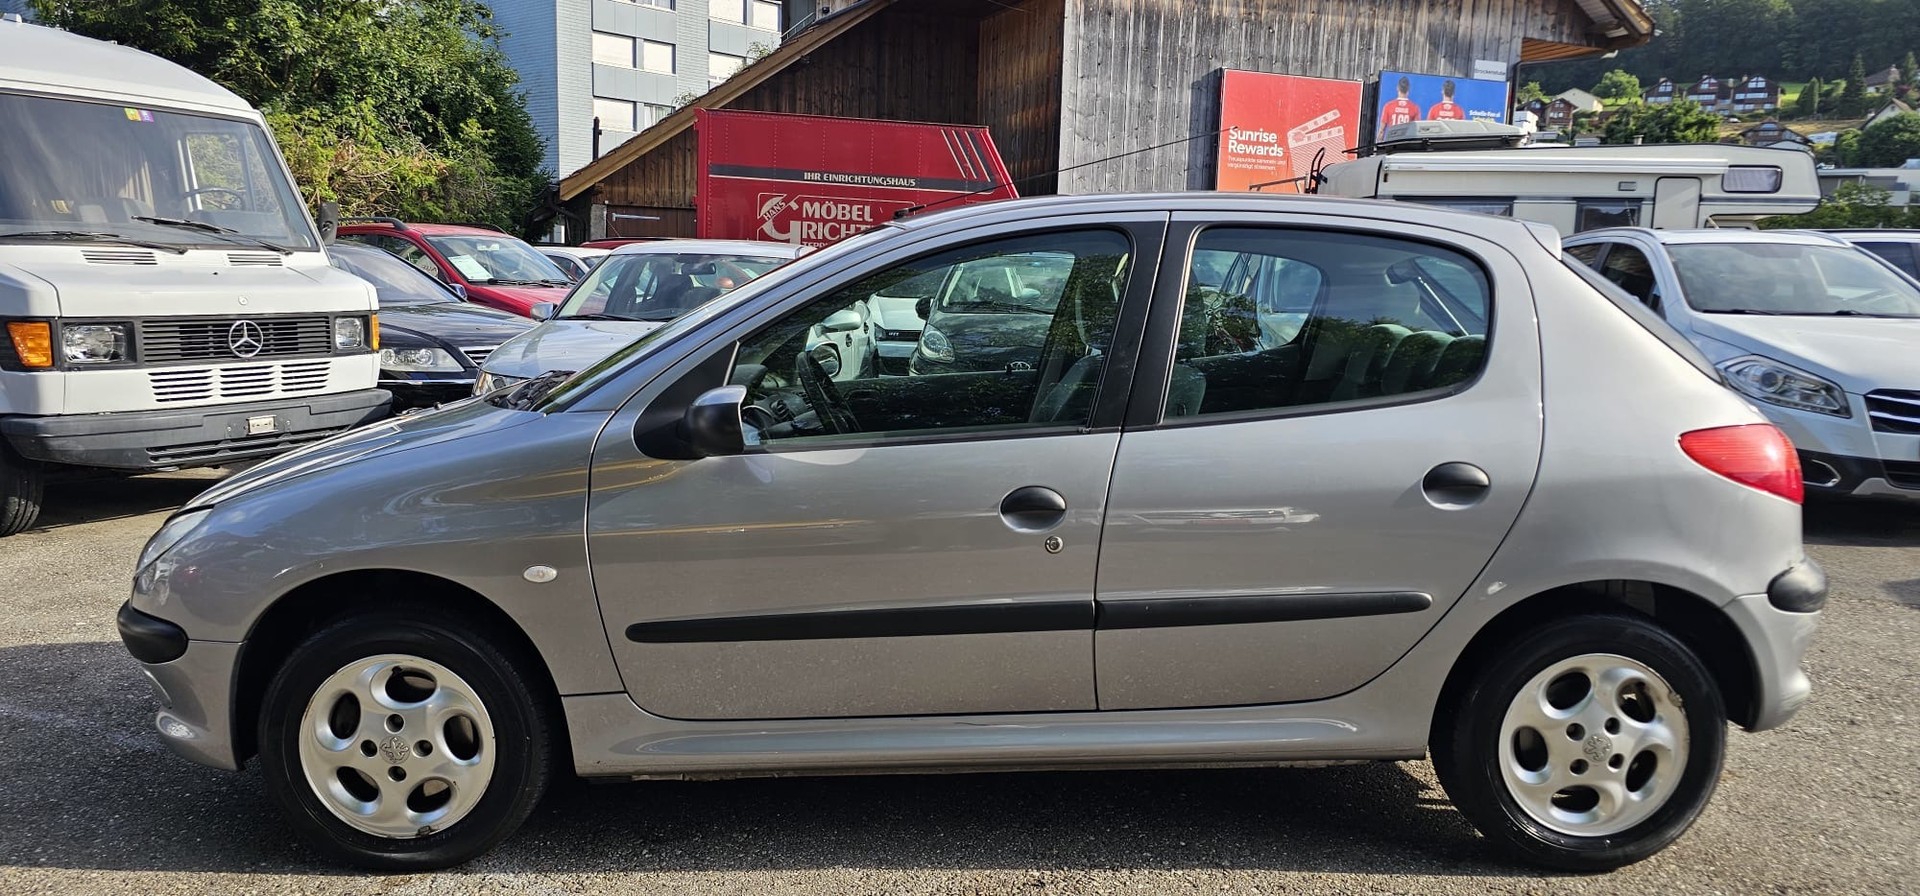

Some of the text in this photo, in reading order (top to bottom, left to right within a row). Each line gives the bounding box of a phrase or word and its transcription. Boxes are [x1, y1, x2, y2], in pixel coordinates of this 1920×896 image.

[1229, 126, 1278, 143] Sunrise
[1228, 140, 1284, 157] Rewards
[804, 172, 916, 187] IHR EINRICHTUNGSHAUS
[763, 200, 787, 221] HANS
[802, 201, 874, 222] MÖBEL
